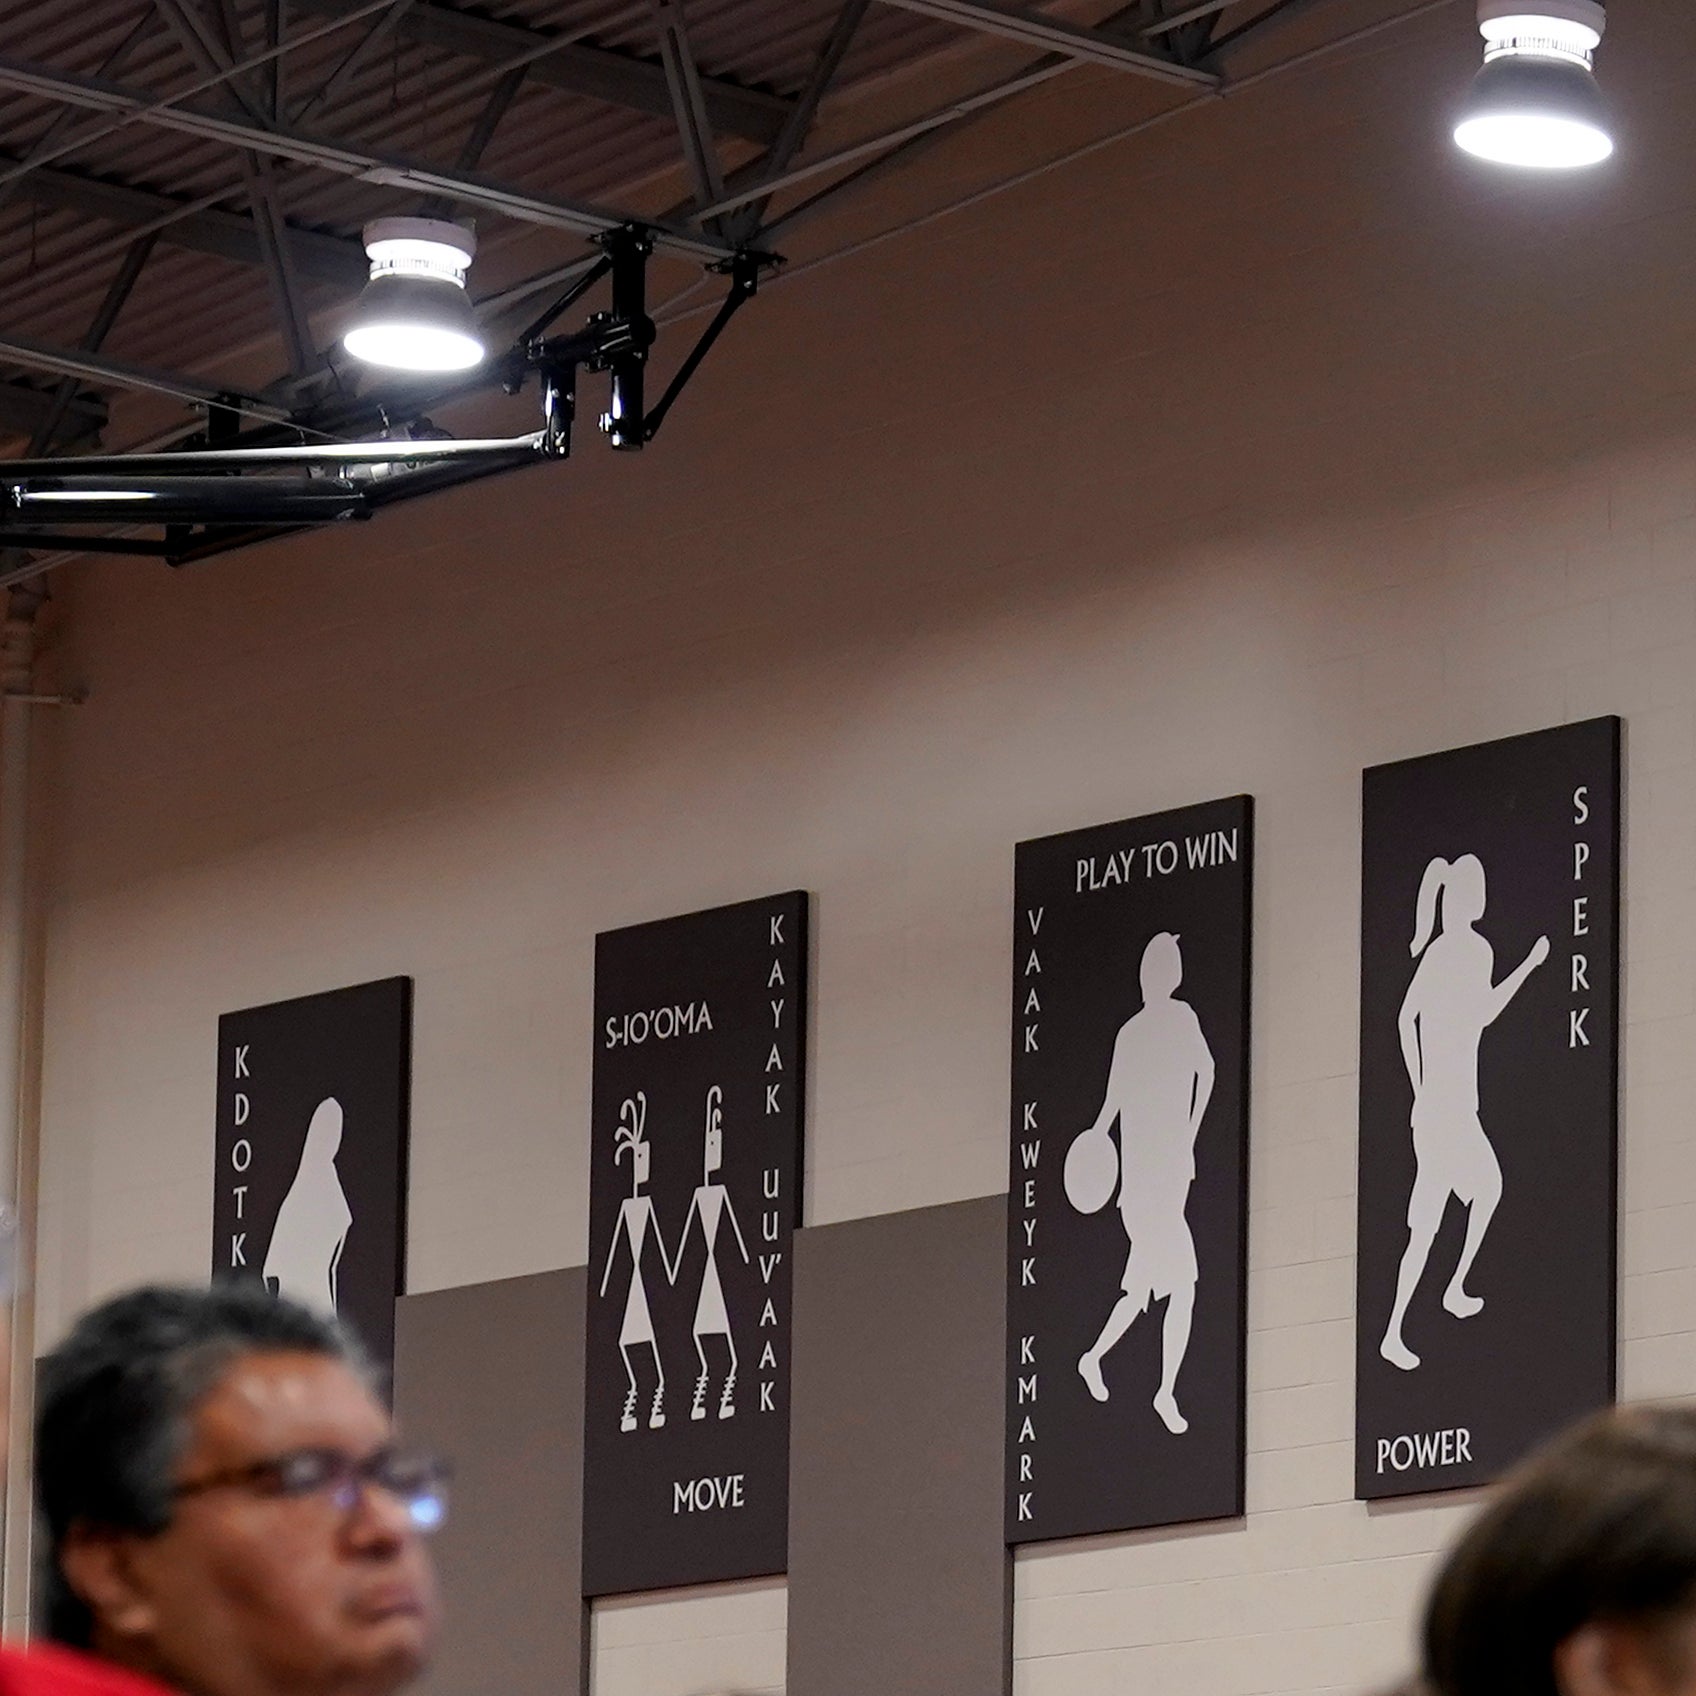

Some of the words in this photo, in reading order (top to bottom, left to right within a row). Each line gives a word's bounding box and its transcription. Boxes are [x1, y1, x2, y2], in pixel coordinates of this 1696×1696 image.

[1075, 847, 1137, 894] PLAY
[1140, 839, 1180, 879] TO
[1184, 827, 1239, 871] WIN
[1568, 785, 1591, 1049] SPERK
[763, 913, 786, 1116] KAYAK
[1023, 906, 1045, 1054] VAAK
[230, 1043, 253, 1268] KDOTK
[1019, 1100, 1042, 1288] KWEYK
[672, 1473, 746, 1515] MOVE
[1017, 1334, 1038, 1522] KMARK
[1375, 1427, 1474, 1475] POWER
